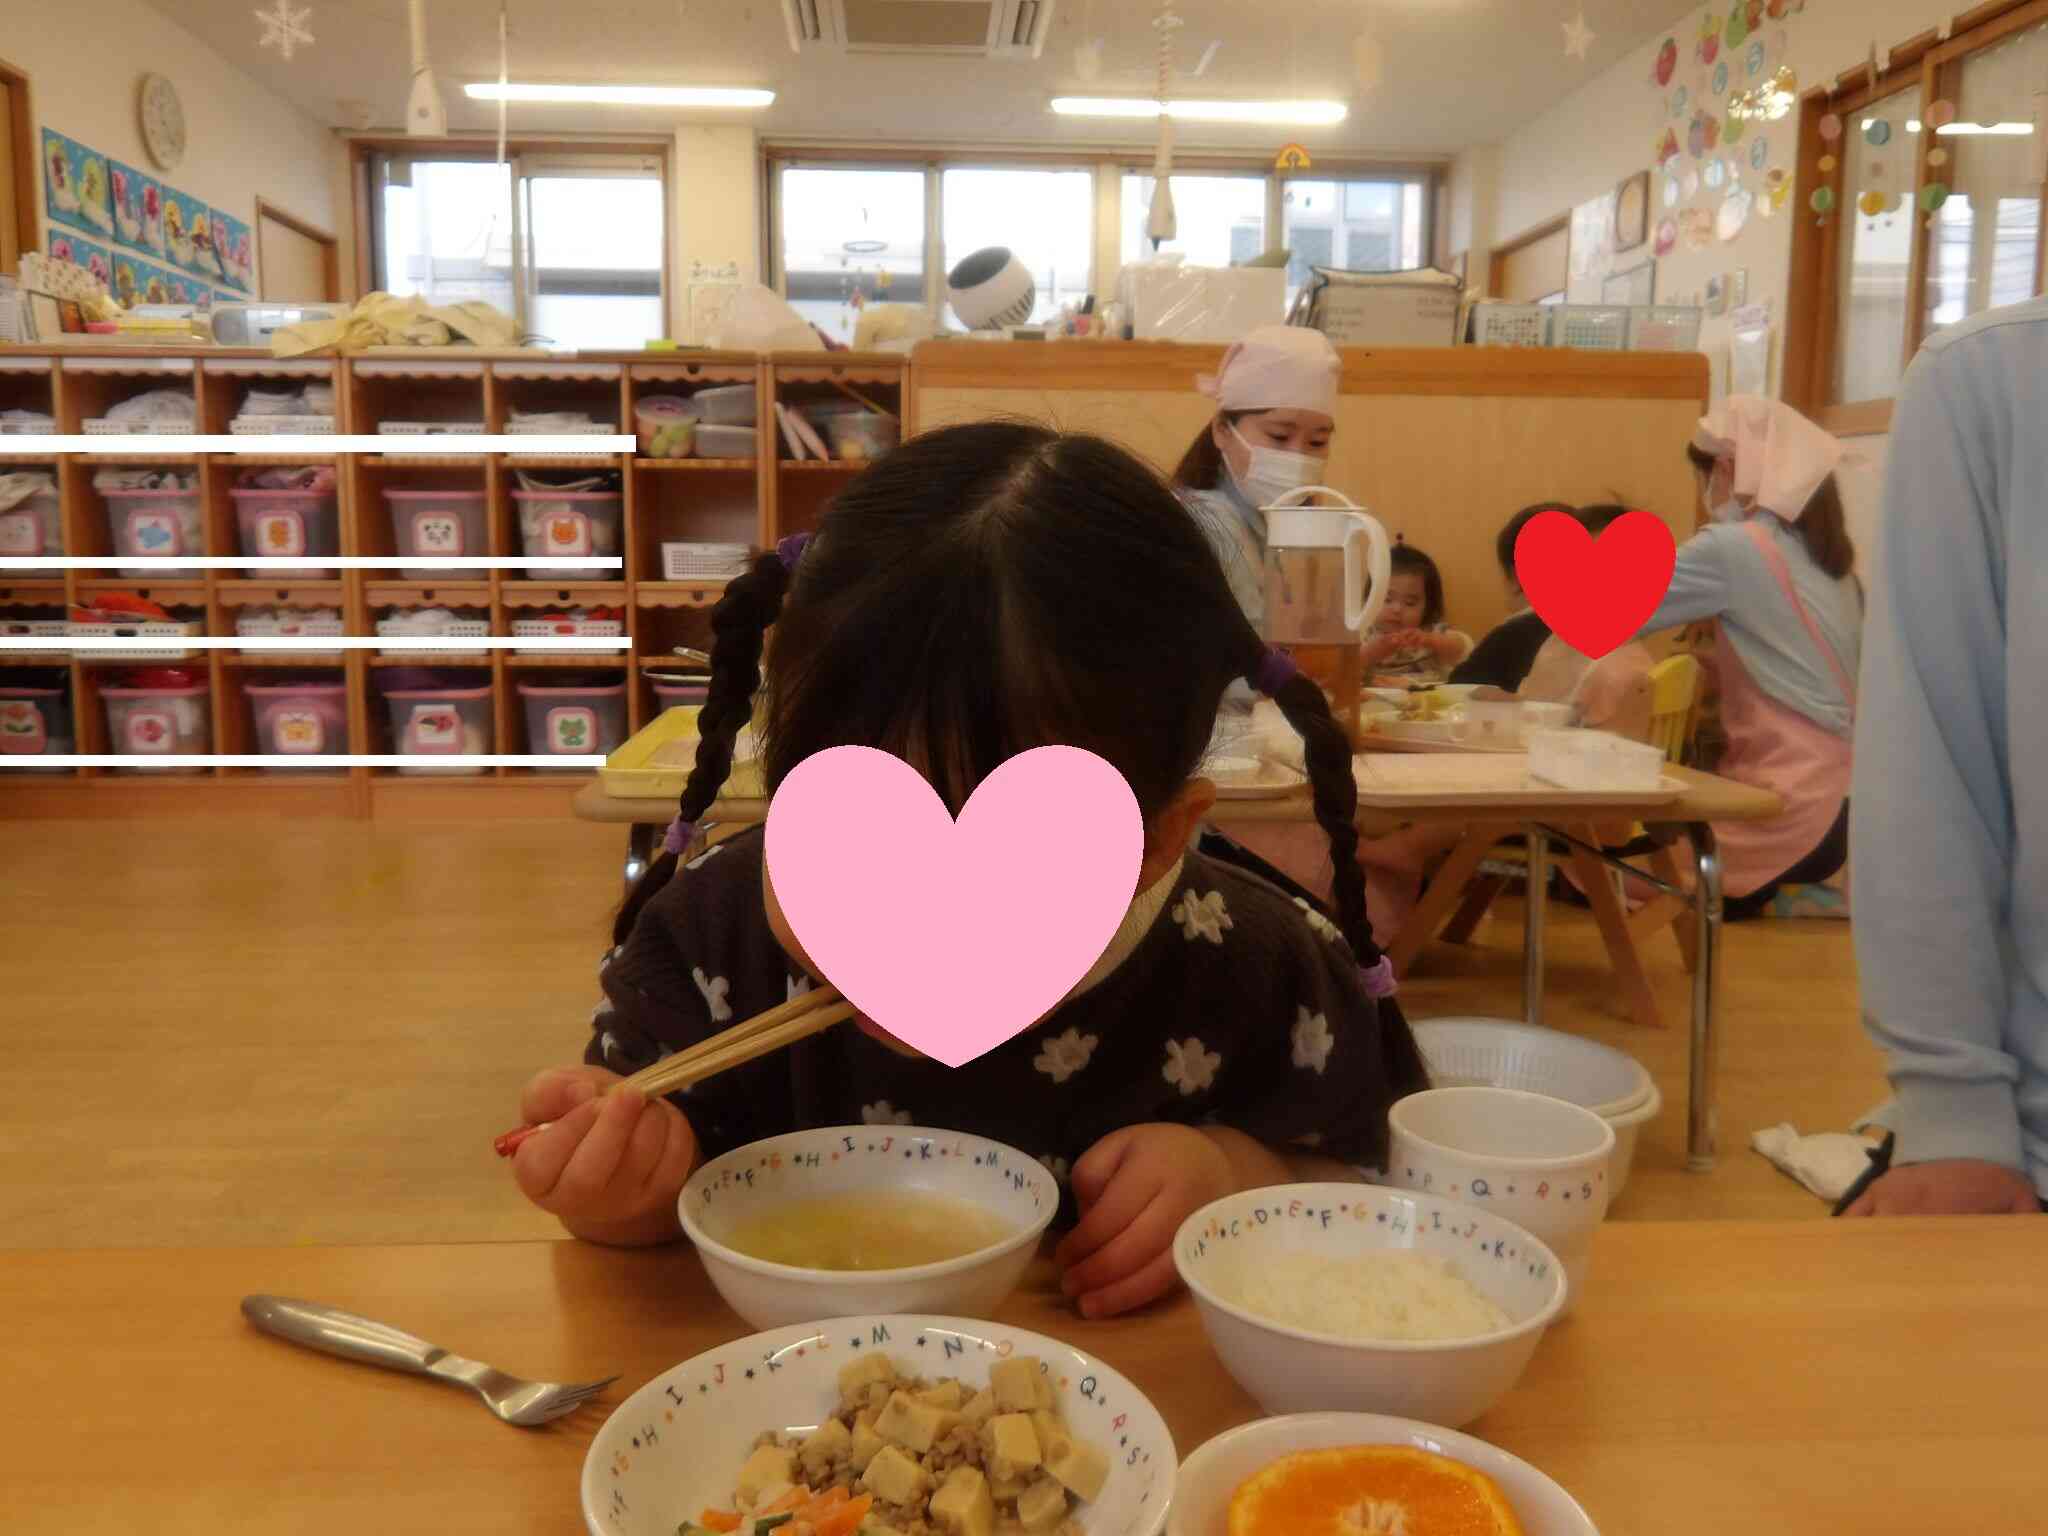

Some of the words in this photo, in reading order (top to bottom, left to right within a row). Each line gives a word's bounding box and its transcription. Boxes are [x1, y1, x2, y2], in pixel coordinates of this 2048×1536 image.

[806, 1152, 821, 1168] H
[842, 1135, 856, 1152] I
[881, 1136, 895, 1152] J
[920, 1143, 932, 1160] K
[985, 1151, 998, 1168] M
[1014, 1172, 1024, 1192] N
[1471, 1178, 1494, 1197] Q
[1230, 1219, 1240, 1238] C
[1254, 1208, 1269, 1225] D
[1288, 1199, 1303, 1218] E
[1320, 1208, 1332, 1230] F
[1431, 1210, 1443, 1229] I
[1494, 1240, 1505, 1258] K
[665, 1384, 684, 1406] I
[714, 1362, 725, 1384] J
[871, 1322, 891, 1345] M
[944, 1336, 964, 1359] N
[1080, 1376, 1097, 1400] Q
[1126, 1446, 1141, 1466] S
